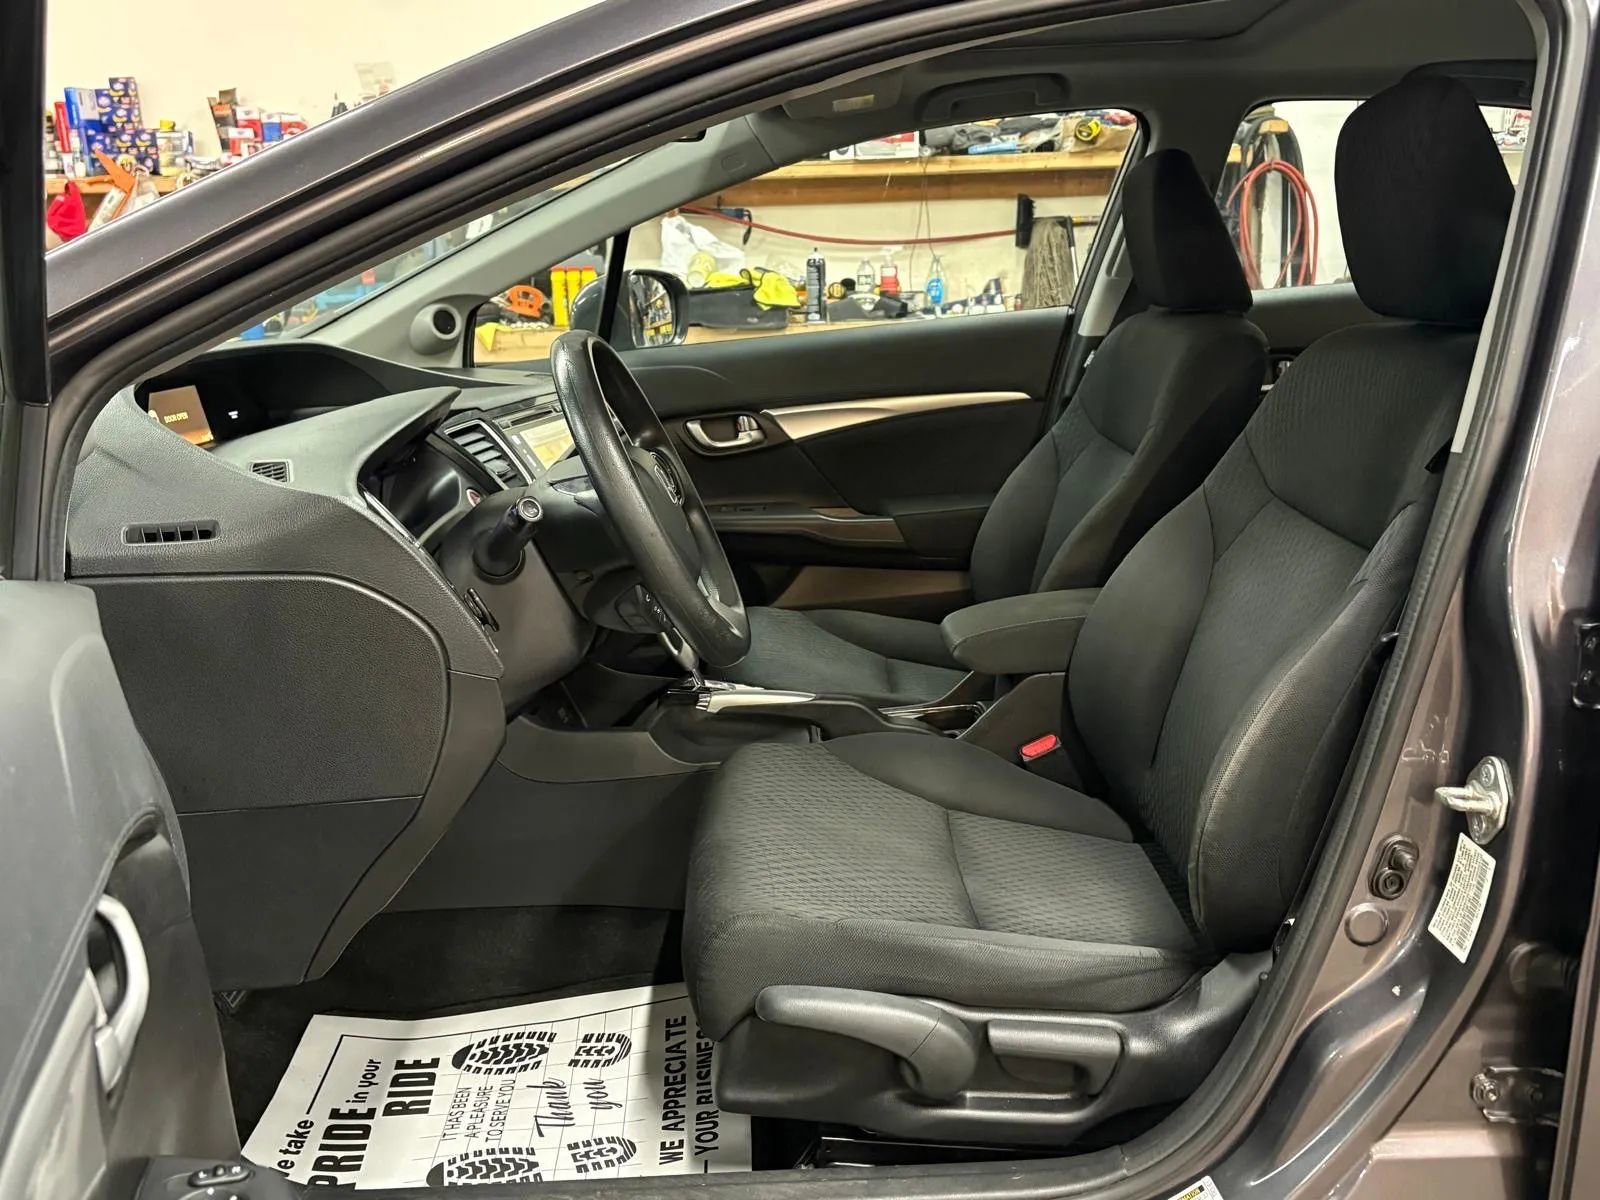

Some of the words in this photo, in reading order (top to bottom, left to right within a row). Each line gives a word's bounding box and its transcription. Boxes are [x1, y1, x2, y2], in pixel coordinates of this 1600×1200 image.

[661, 1015, 687, 1131] APPRECIATE
[696, 1021, 714, 1105] BUSINE
[381, 1057, 441, 1117] RIDE
[451, 1086, 472, 1109] BEEN
[497, 1079, 516, 1098] YOU
[582, 1077, 623, 1110] you
[307, 1107, 377, 1188] PRIDE
[345, 1092, 369, 1103] in
[357, 1058, 382, 1088] your
[445, 1110, 465, 1130] HAS
[466, 1085, 494, 1130] PLEASURE
[489, 1099, 511, 1127] SERVE
[526, 1077, 575, 1137] Thank
[279, 1119, 315, 1155] take
[440, 1132, 457, 1141] IT
[485, 1129, 503, 1142] TO
[694, 1109, 719, 1156] YOUR
[659, 1139, 684, 1165] WE
